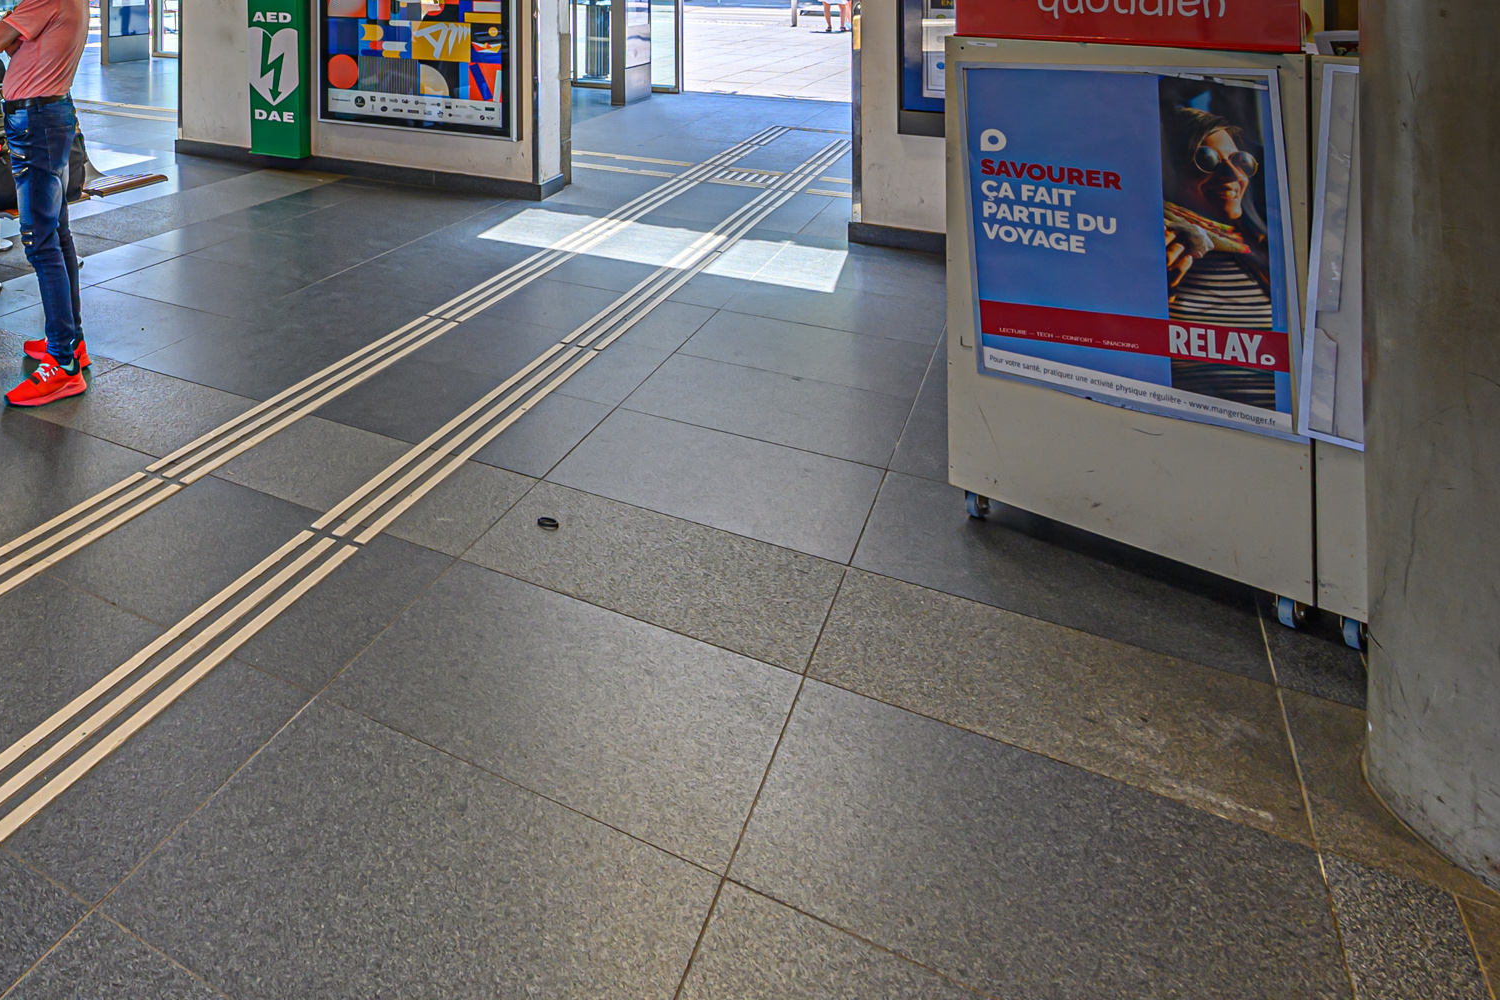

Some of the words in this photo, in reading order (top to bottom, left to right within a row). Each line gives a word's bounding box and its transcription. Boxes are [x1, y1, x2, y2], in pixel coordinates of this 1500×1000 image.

[252, 12, 292, 23] AED
[254, 109, 295, 123] DAE
[980, 158, 1123, 190] SAVOURER
[981, 180, 1015, 201] ÇA
[1021, 184, 1076, 206] FAIT
[982, 201, 1070, 229] PARTIE
[1077, 213, 1117, 234] DU
[982, 222, 1086, 254] VOYAGE
[999, 327, 1027, 336] LECTURE
[1062, 334, 1093, 344] CONFORT
[1102, 340, 1139, 349] SNACKING
[1168, 324, 1263, 364] RELAY
[989, 354, 1004, 364] Pour
[1005, 360, 1021, 368] votre
[1023, 363, 1041, 373] santé,
[1043, 367, 1074, 381] pratiquez
[1075, 375, 1088, 383] une
[1090, 377, 1113, 389] activité
[1115, 383, 1147, 397] physique
[1149, 391, 1182, 405] régulière
[1189, 401, 1276, 426] www.mangerbouger.fr
